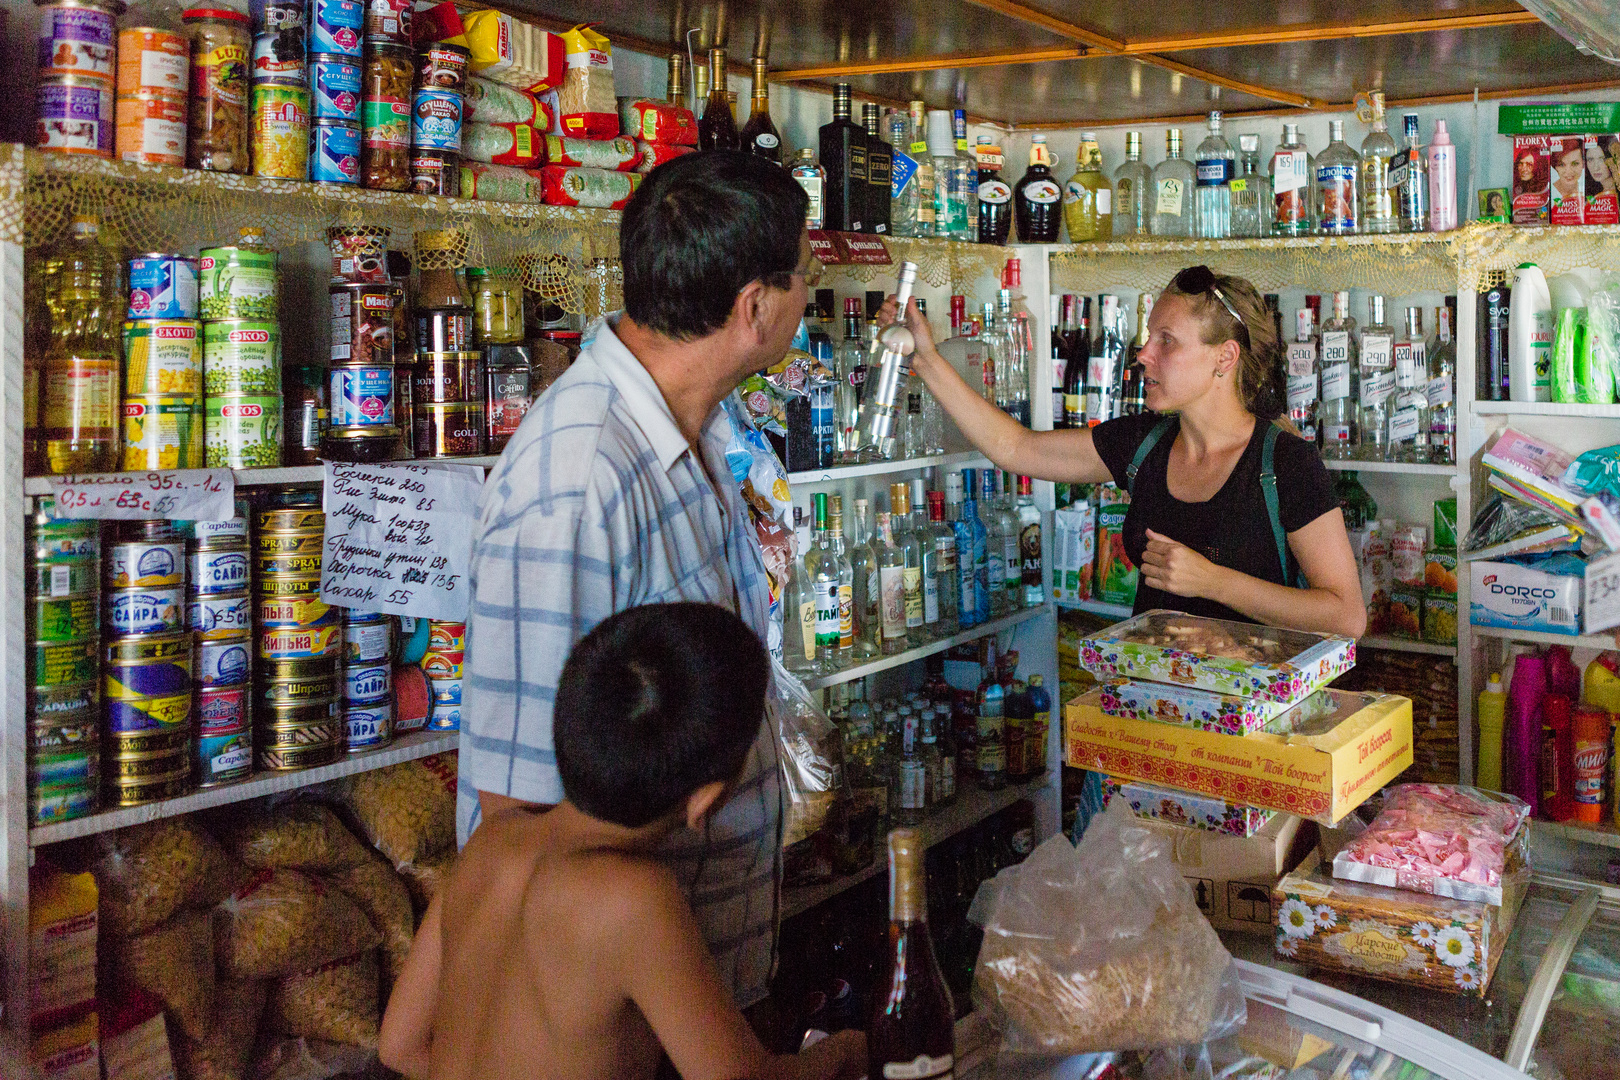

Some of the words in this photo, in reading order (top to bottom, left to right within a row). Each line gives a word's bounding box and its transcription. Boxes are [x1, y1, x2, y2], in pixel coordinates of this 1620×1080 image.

[420, 101, 459, 116] СГУЩЕНКА
[1515, 137, 1548, 149] FLOREX
[871, 161, 889, 170] ZERO
[981, 154, 997, 163] 250
[1392, 168, 1408, 183] 120
[1561, 200, 1578, 208] MISS
[1594, 198, 1612, 206] MISS
[1557, 206, 1580, 214] MAGIC
[240, 353, 265, 362] орошек
[1326, 347, 1345, 359] 280
[1366, 352, 1387, 365] 290
[1396, 347, 1410, 360] 220
[497, 383, 525, 395] Caffito
[454, 429, 479, 437] GOLD
[398, 479, 426, 493] 250
[60, 488, 87, 509] 0,5
[153, 496, 180, 514] 55
[416, 497, 437, 512] 85
[332, 502, 381, 531] Мука
[259, 539, 299, 549] SPRATS
[414, 534, 434, 546] 42
[429, 556, 448, 570] 138
[262, 582, 309, 592] ШПРОТЫ
[430, 574, 462, 591] 135
[323, 576, 378, 603] Сахар
[384, 589, 415, 605] 55
[1491, 584, 1557, 600] DORCO
[115, 606, 159, 622] САЙРА
[213, 609, 235, 623] 65
[347, 722, 375, 738] АЙРА
[1071, 720, 1107, 738] Сладости
[1118, 729, 1151, 752] Вашему
[1153, 738, 1178, 757] столу
[1191, 747, 1205, 760] от
[1206, 750, 1253, 770] компании
[1356, 741, 1369, 765] Той
[1354, 933, 1400, 952] Царские
[1350, 945, 1401, 962] Сладости
